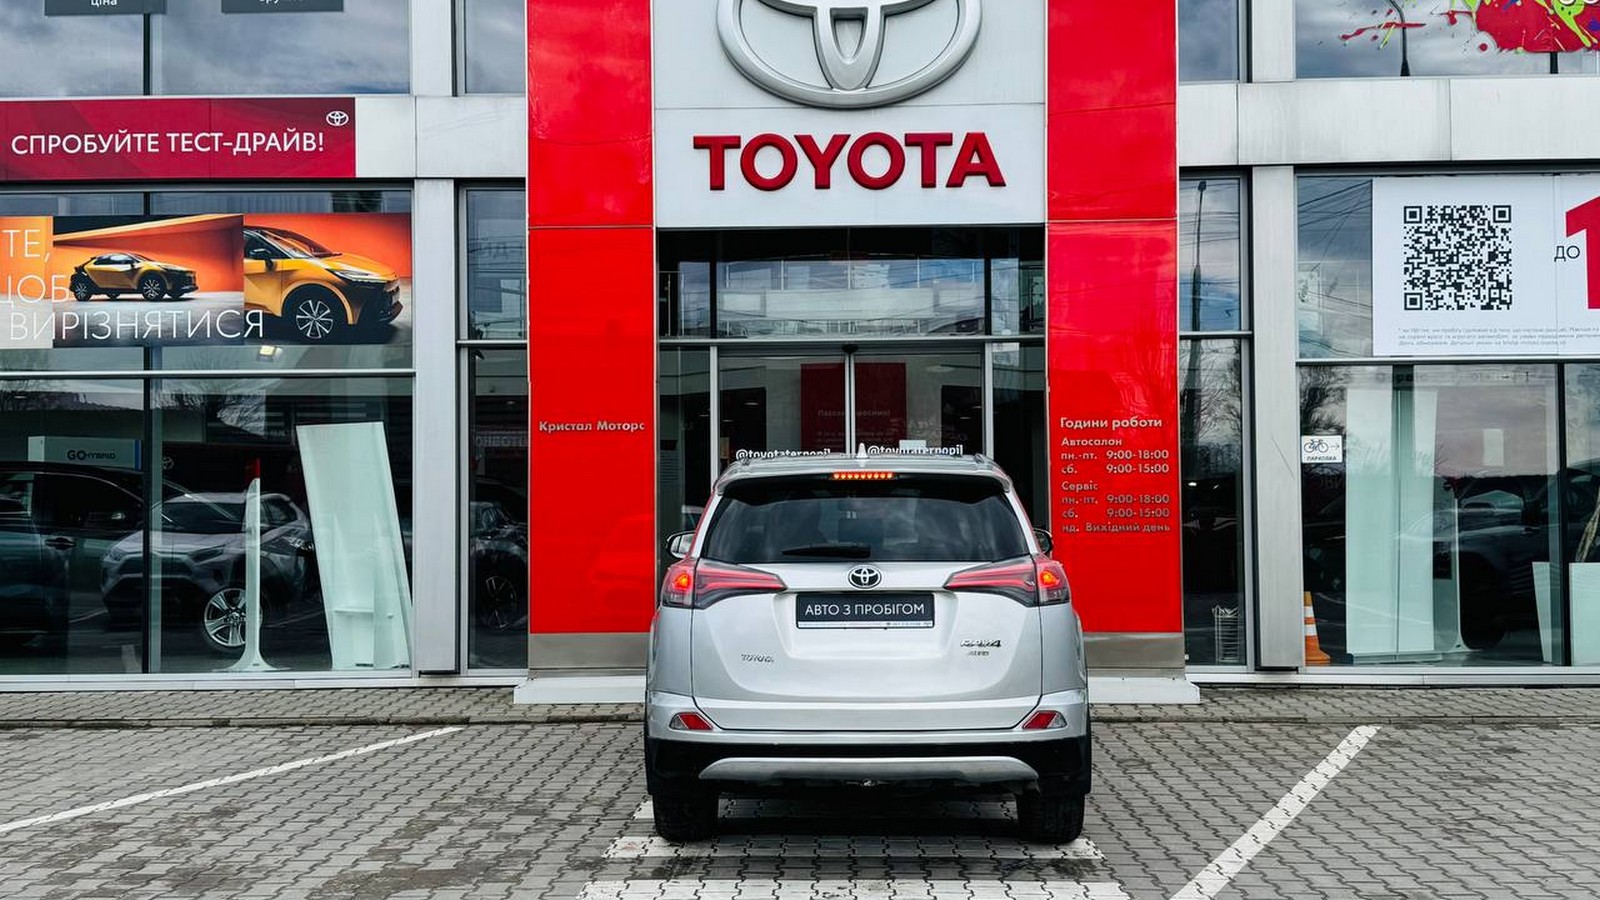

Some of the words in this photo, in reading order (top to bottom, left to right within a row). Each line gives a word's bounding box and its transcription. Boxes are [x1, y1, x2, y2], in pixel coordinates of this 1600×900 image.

[11, 130, 159, 155] СПРОБУЙТЕ
[166, 128, 325, 156] ТЕСТ-ДРАЙВ!
[693, 131, 1006, 191] TOYOTA
[1554, 245, 1580, 262] ДО
[10, 309, 263, 341] ВИРІЗНЯТИСЯ
[539, 420, 592, 434] Кристал
[596, 420, 645, 433] Моторс
[1060, 417, 1108, 429] Години
[1112, 416, 1162, 430] роботи
[1061, 438, 1122, 446] Автосалон
[1106, 450, 1169, 459] 9:00-18:00
[1061, 464, 1078, 474] сб.
[1106, 464, 1169, 473] 9:00-15:00
[1061, 480, 1098, 492] Сервіс
[1107, 494, 1169, 503] 9:00-18:00
[1062, 507, 1079, 518] сб.
[1107, 508, 1169, 517] 9:00-15:00
[1062, 524, 1080, 532] нд.
[1086, 521, 1140, 532] Вихідний
[1143, 524, 1170, 532] день
[805, 604, 839, 615] АВТО
[843, 604, 851, 615] З
[855, 603, 925, 615] ПРОБІГОМ
